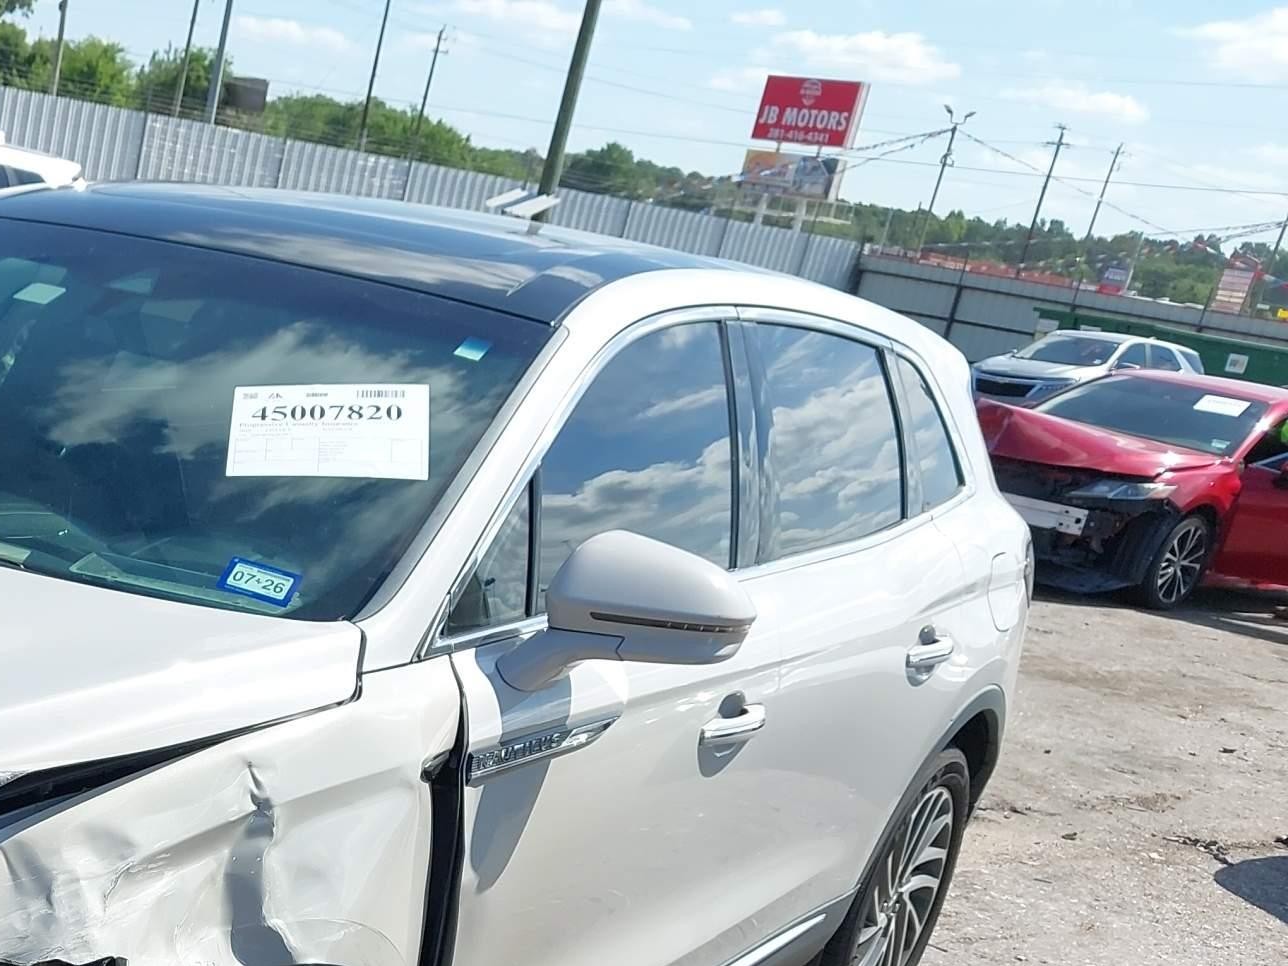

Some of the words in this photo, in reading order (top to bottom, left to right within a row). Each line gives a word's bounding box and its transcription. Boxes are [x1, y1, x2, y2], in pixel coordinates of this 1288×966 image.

[758, 105, 779, 124] JB
[782, 106, 849, 131] MOTORS
[251, 404, 403, 421] 45007820
